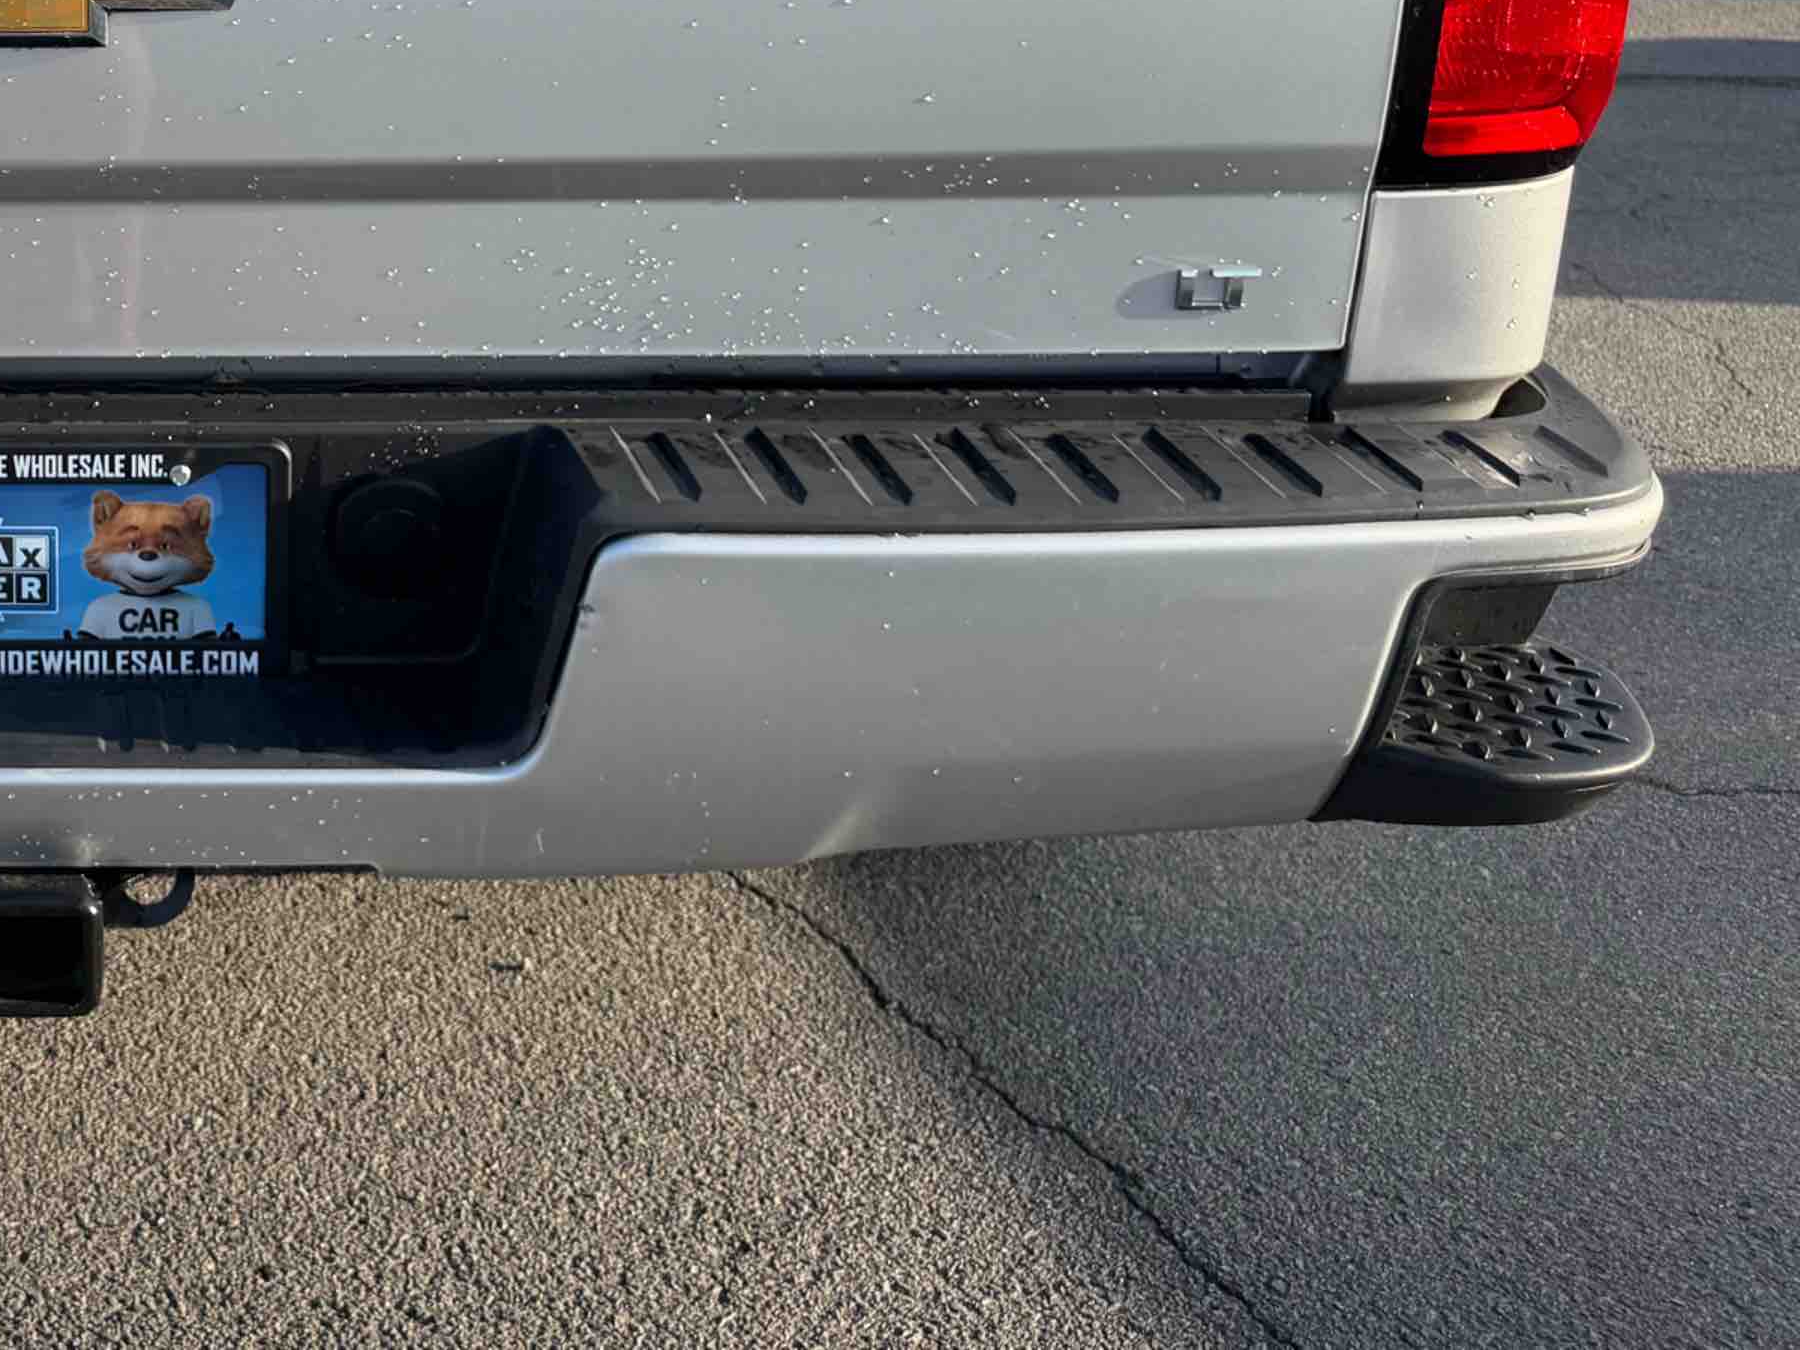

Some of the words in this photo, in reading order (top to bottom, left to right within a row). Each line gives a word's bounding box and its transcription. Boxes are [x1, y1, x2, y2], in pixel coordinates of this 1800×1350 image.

[1175, 268, 1262, 311] LT
[13, 454, 125, 478] WHOLESALE
[131, 454, 168, 478] INC.
[119, 608, 179, 632] CAR
